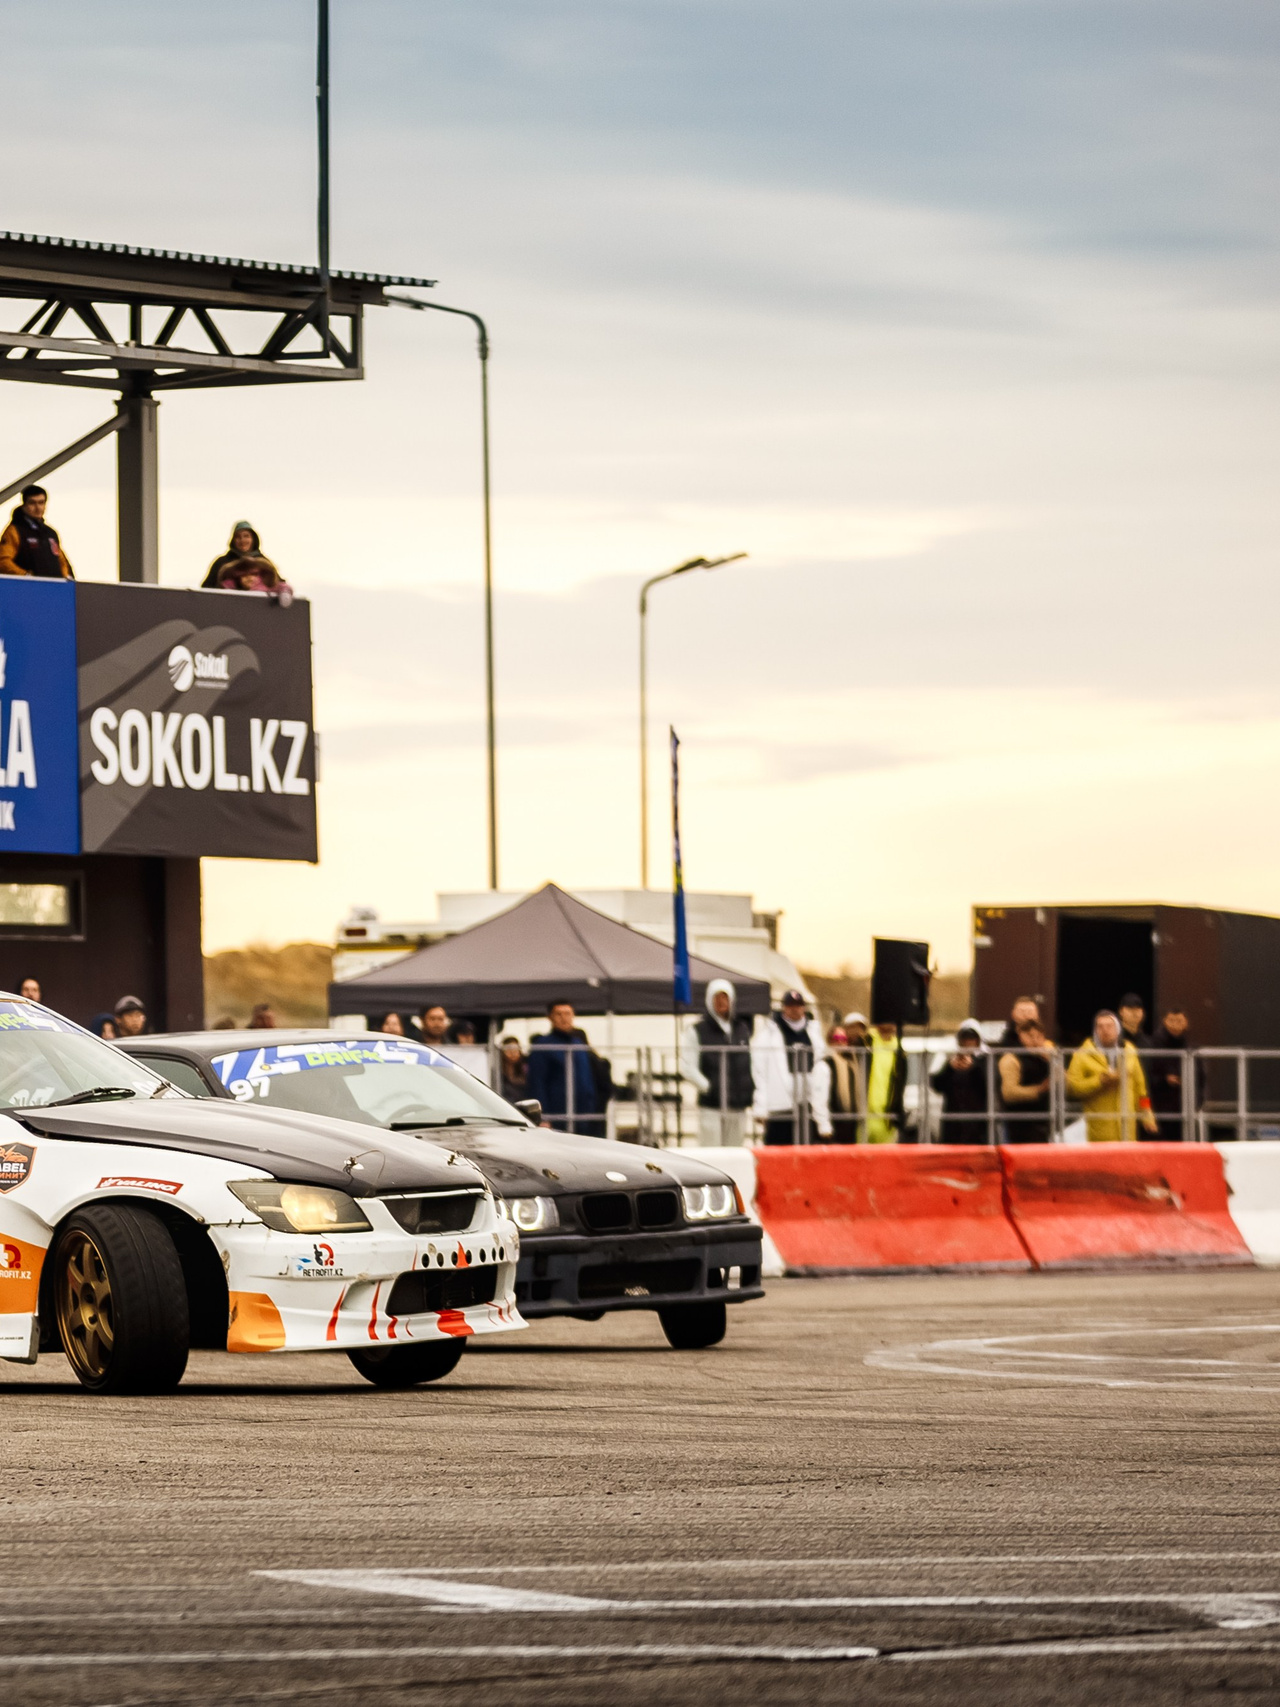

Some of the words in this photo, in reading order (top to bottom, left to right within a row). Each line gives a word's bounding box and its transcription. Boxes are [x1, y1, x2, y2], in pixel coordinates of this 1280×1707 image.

[90, 707, 310, 795] SOKOL.KZ
[229, 1075, 271, 1101] 97
[302, 1268, 344, 1277] RETROFIT.KZ
